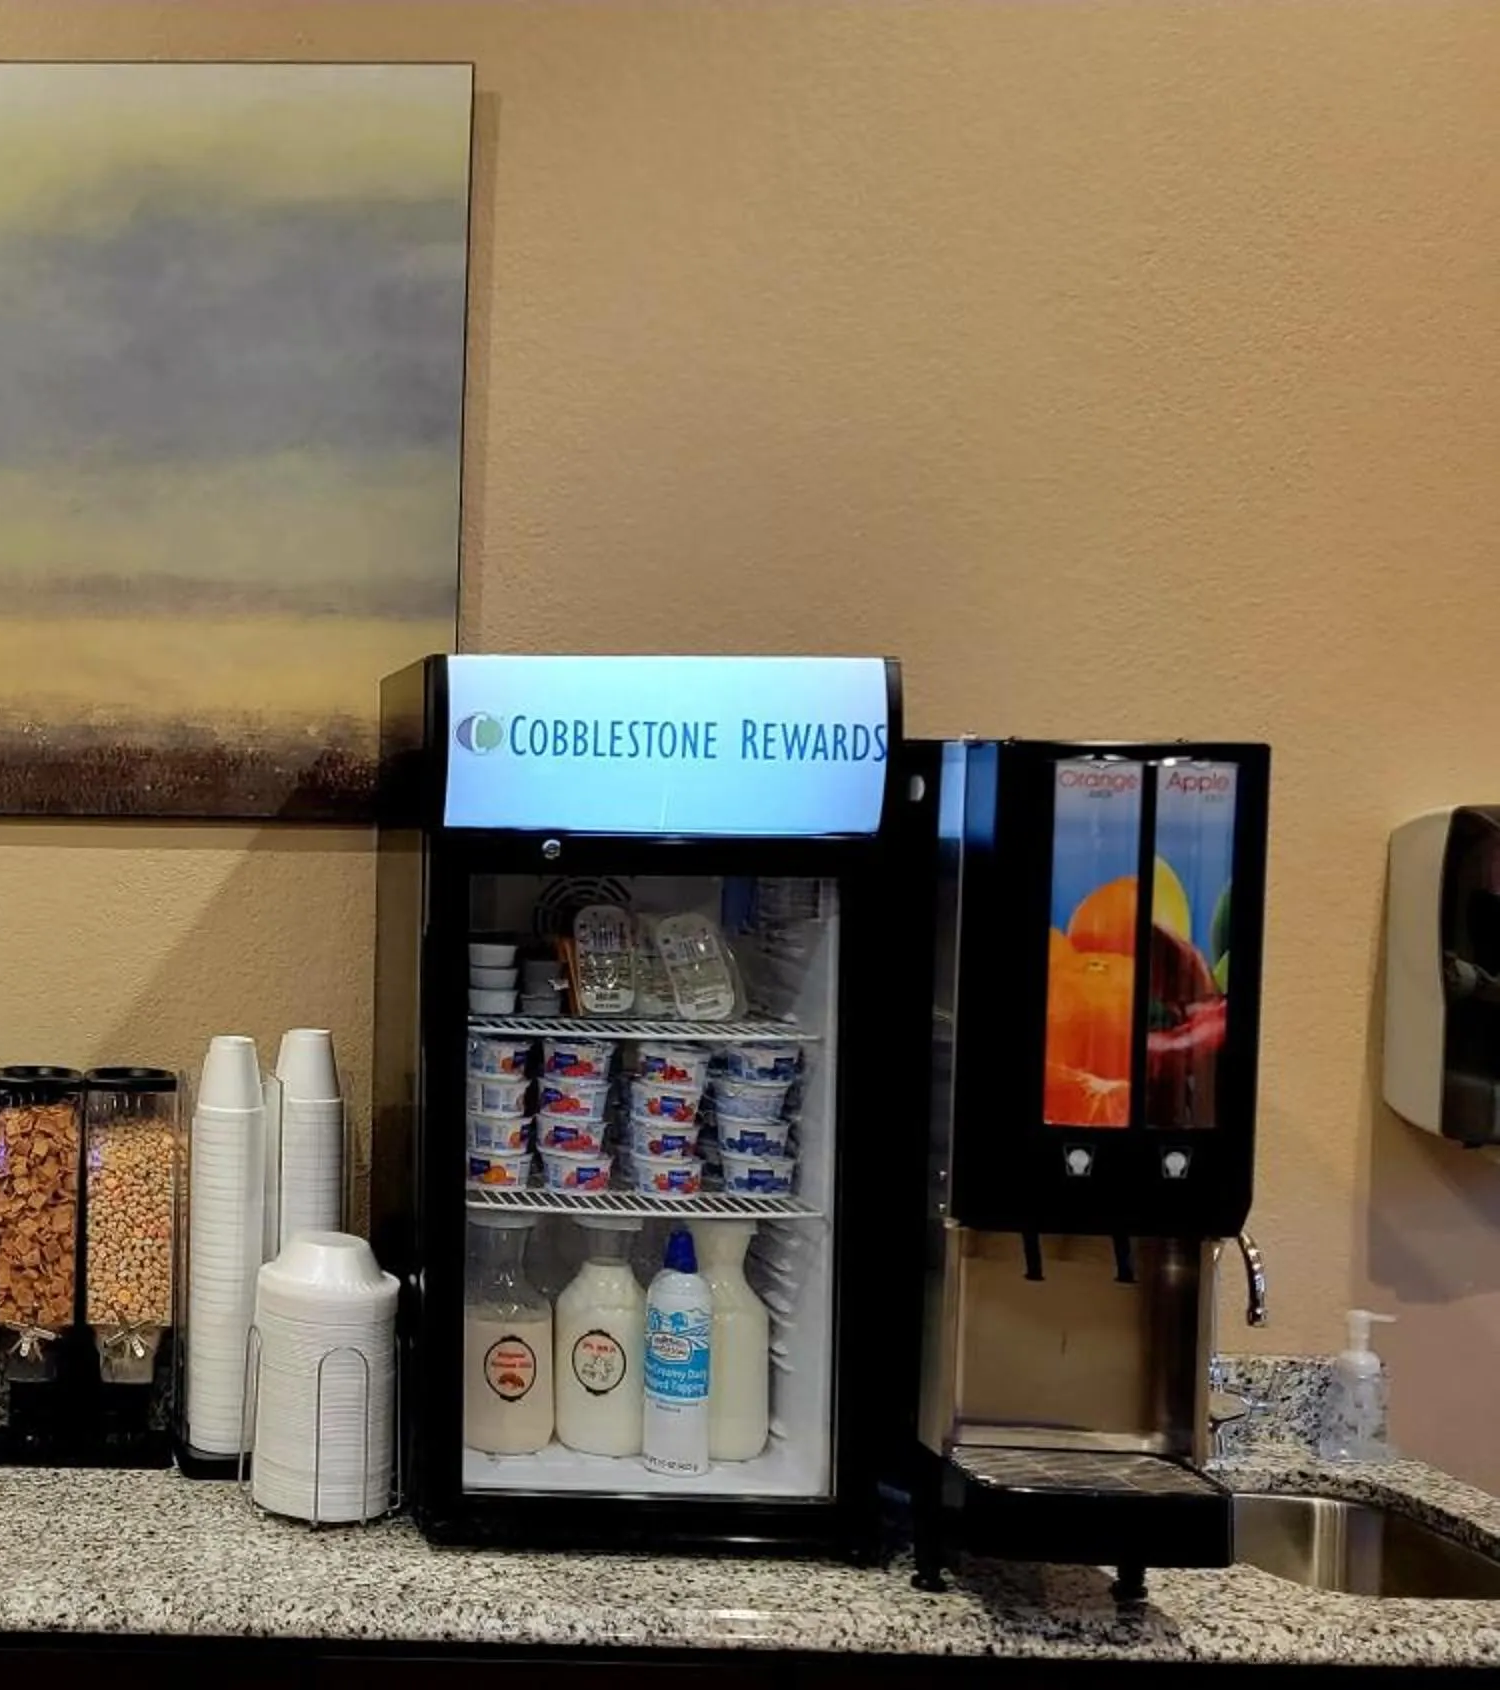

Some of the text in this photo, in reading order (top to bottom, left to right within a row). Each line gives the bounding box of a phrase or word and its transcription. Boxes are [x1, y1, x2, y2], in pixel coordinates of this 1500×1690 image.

[509, 714, 719, 760] COBBLESTONE
[740, 718, 888, 763] REWARDS
[1060, 770, 1138, 792] Orange
[1166, 772, 1229, 793] Apple
